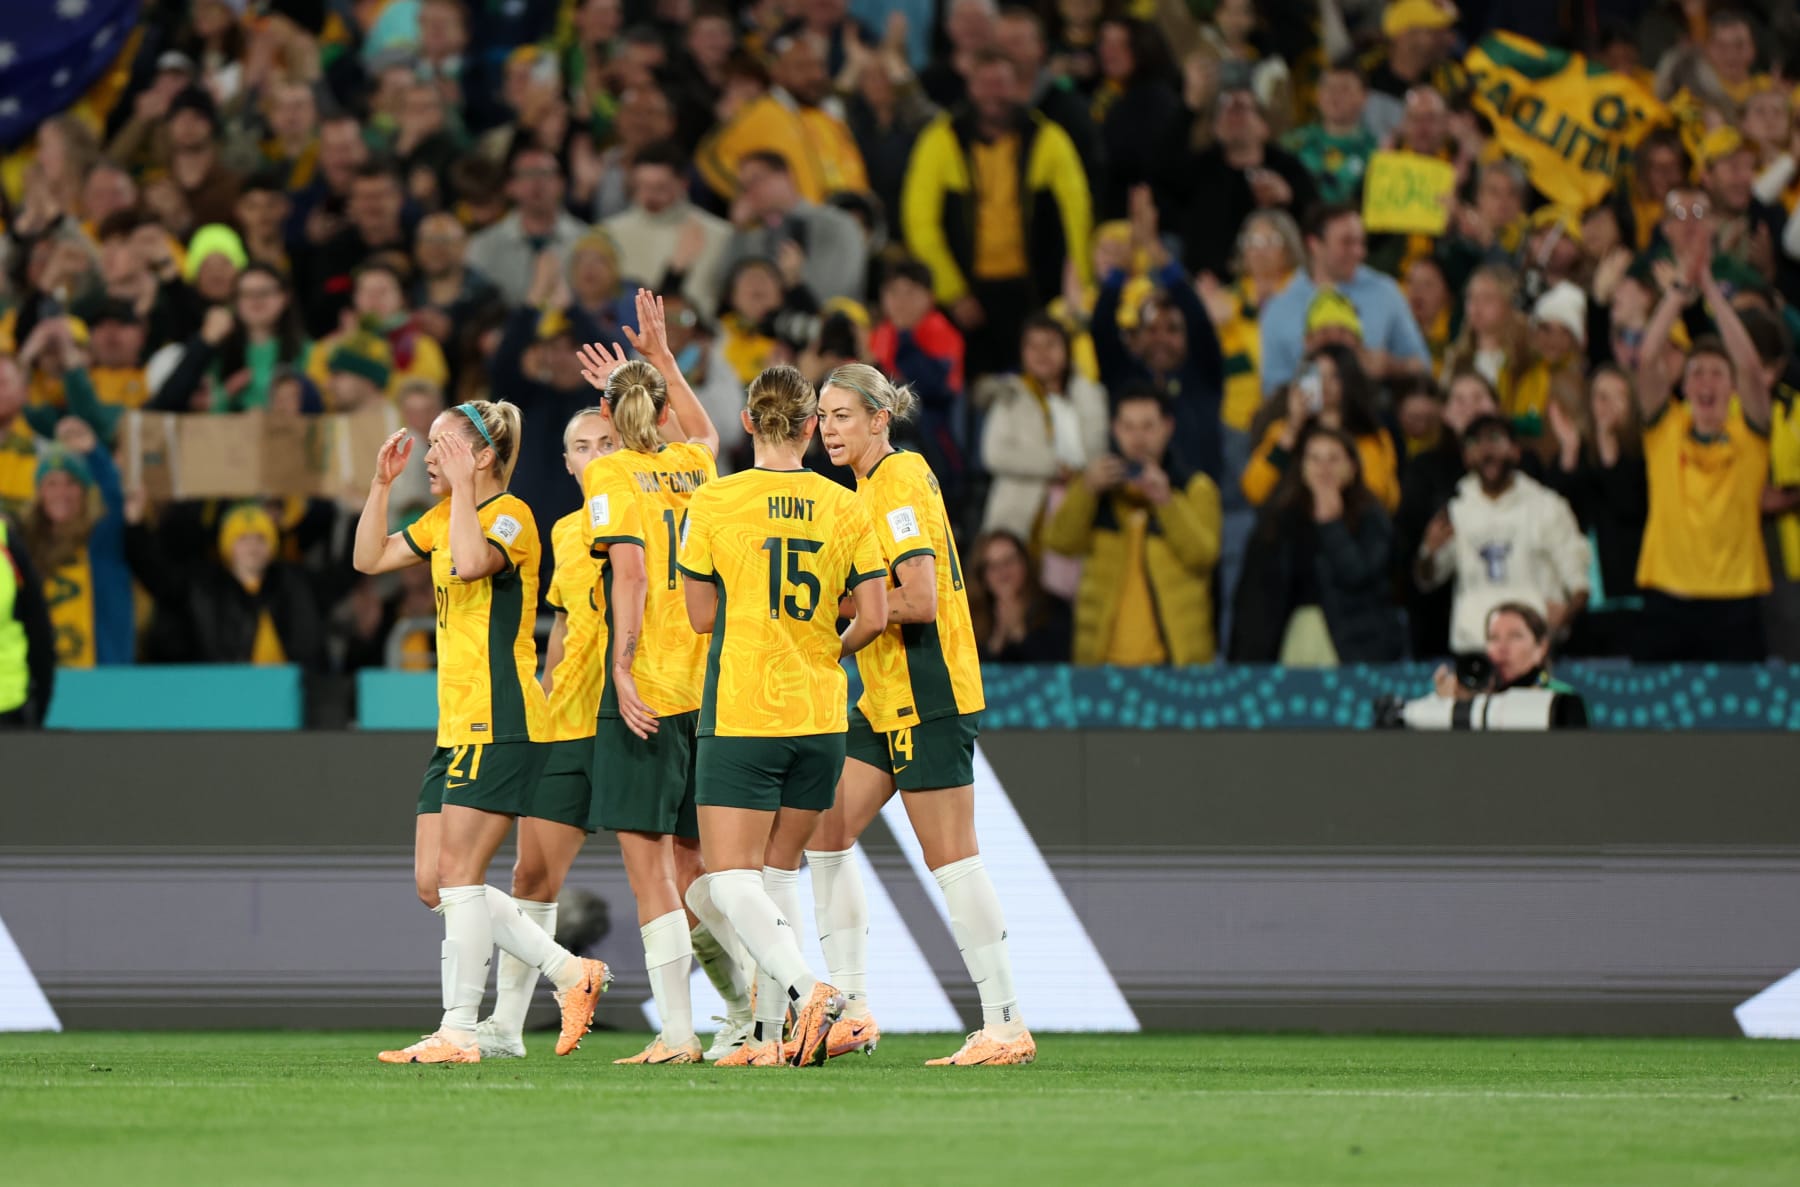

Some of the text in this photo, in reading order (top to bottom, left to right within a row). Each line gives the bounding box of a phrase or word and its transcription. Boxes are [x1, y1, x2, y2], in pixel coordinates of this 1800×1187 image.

[768, 496, 815, 522] HUNT
[761, 537, 824, 621] 15
[447, 744, 484, 780] 21
